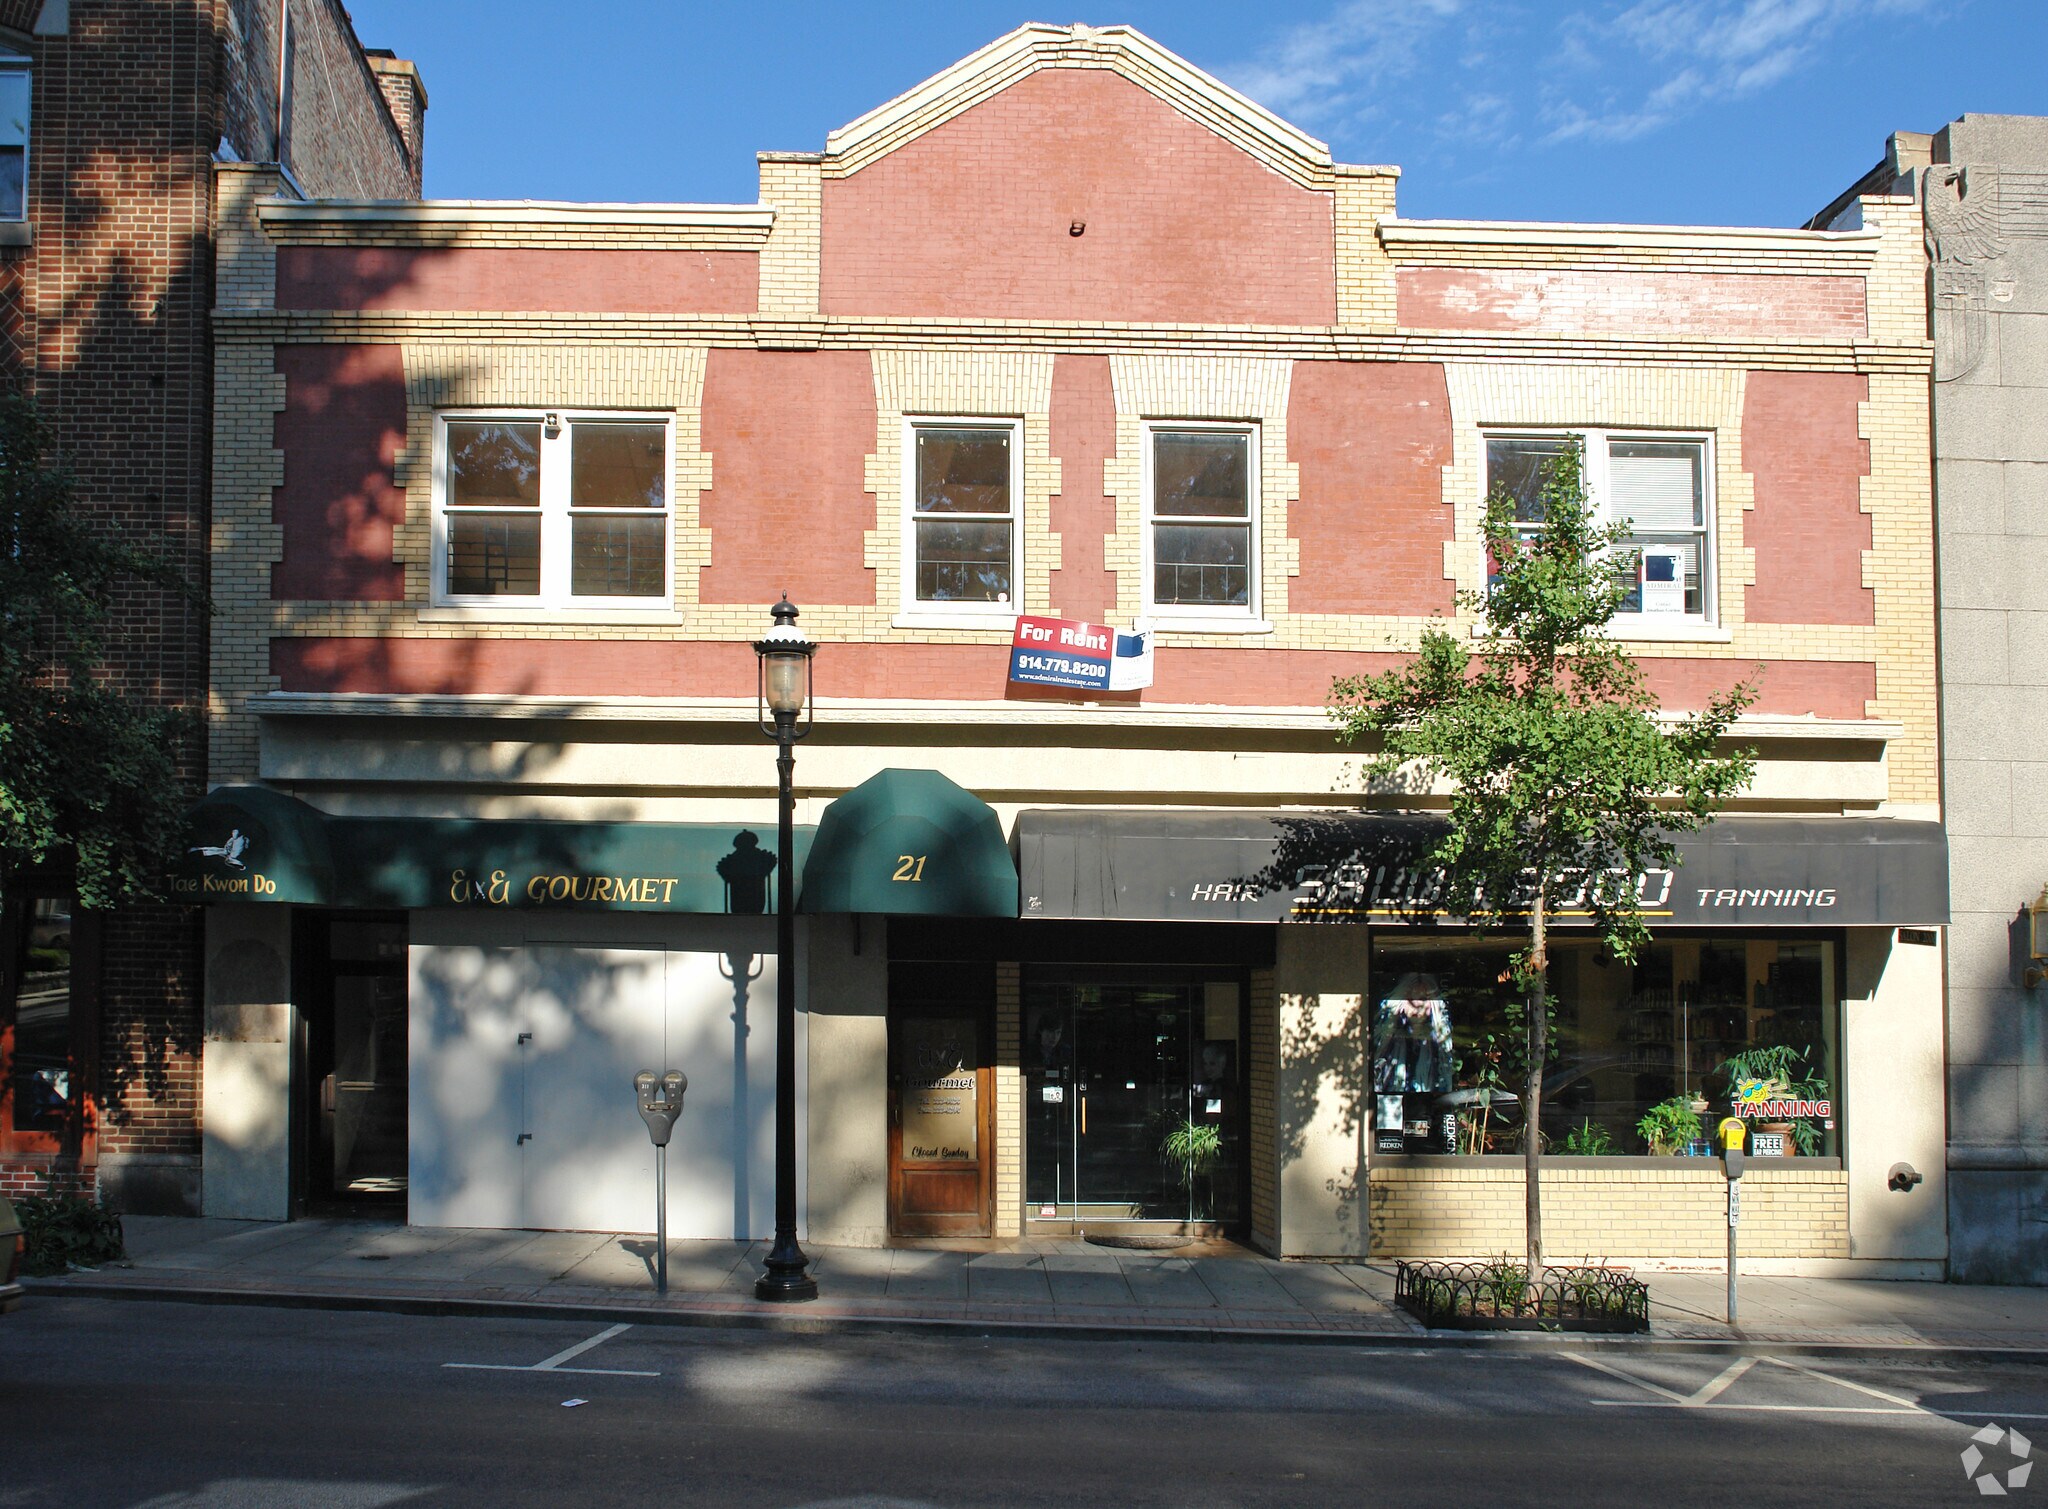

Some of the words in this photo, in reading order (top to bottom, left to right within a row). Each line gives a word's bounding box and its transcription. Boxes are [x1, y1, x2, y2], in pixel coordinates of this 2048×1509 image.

[1020, 622, 1054, 642] For
[1060, 627, 1107, 651] Rent
[1018, 655, 1107, 678] 914.779.8200
[892, 855, 927, 882] 21
[166, 874, 198, 892] Tae
[203, 873, 248, 893] Kwon
[253, 874, 277, 895] Do
[526, 875, 679, 904] GOURMET
[1191, 883, 1262, 903] HAIR
[1697, 889, 1837, 907] TANNING
[1732, 1100, 1831, 1118] TANNING
[1446, 1114, 1456, 1155] REDKEN
[1754, 1138, 1783, 1149] FREE!
[912, 1146, 939, 1158] Closed
[941, 1147, 969, 1159] Sunday
